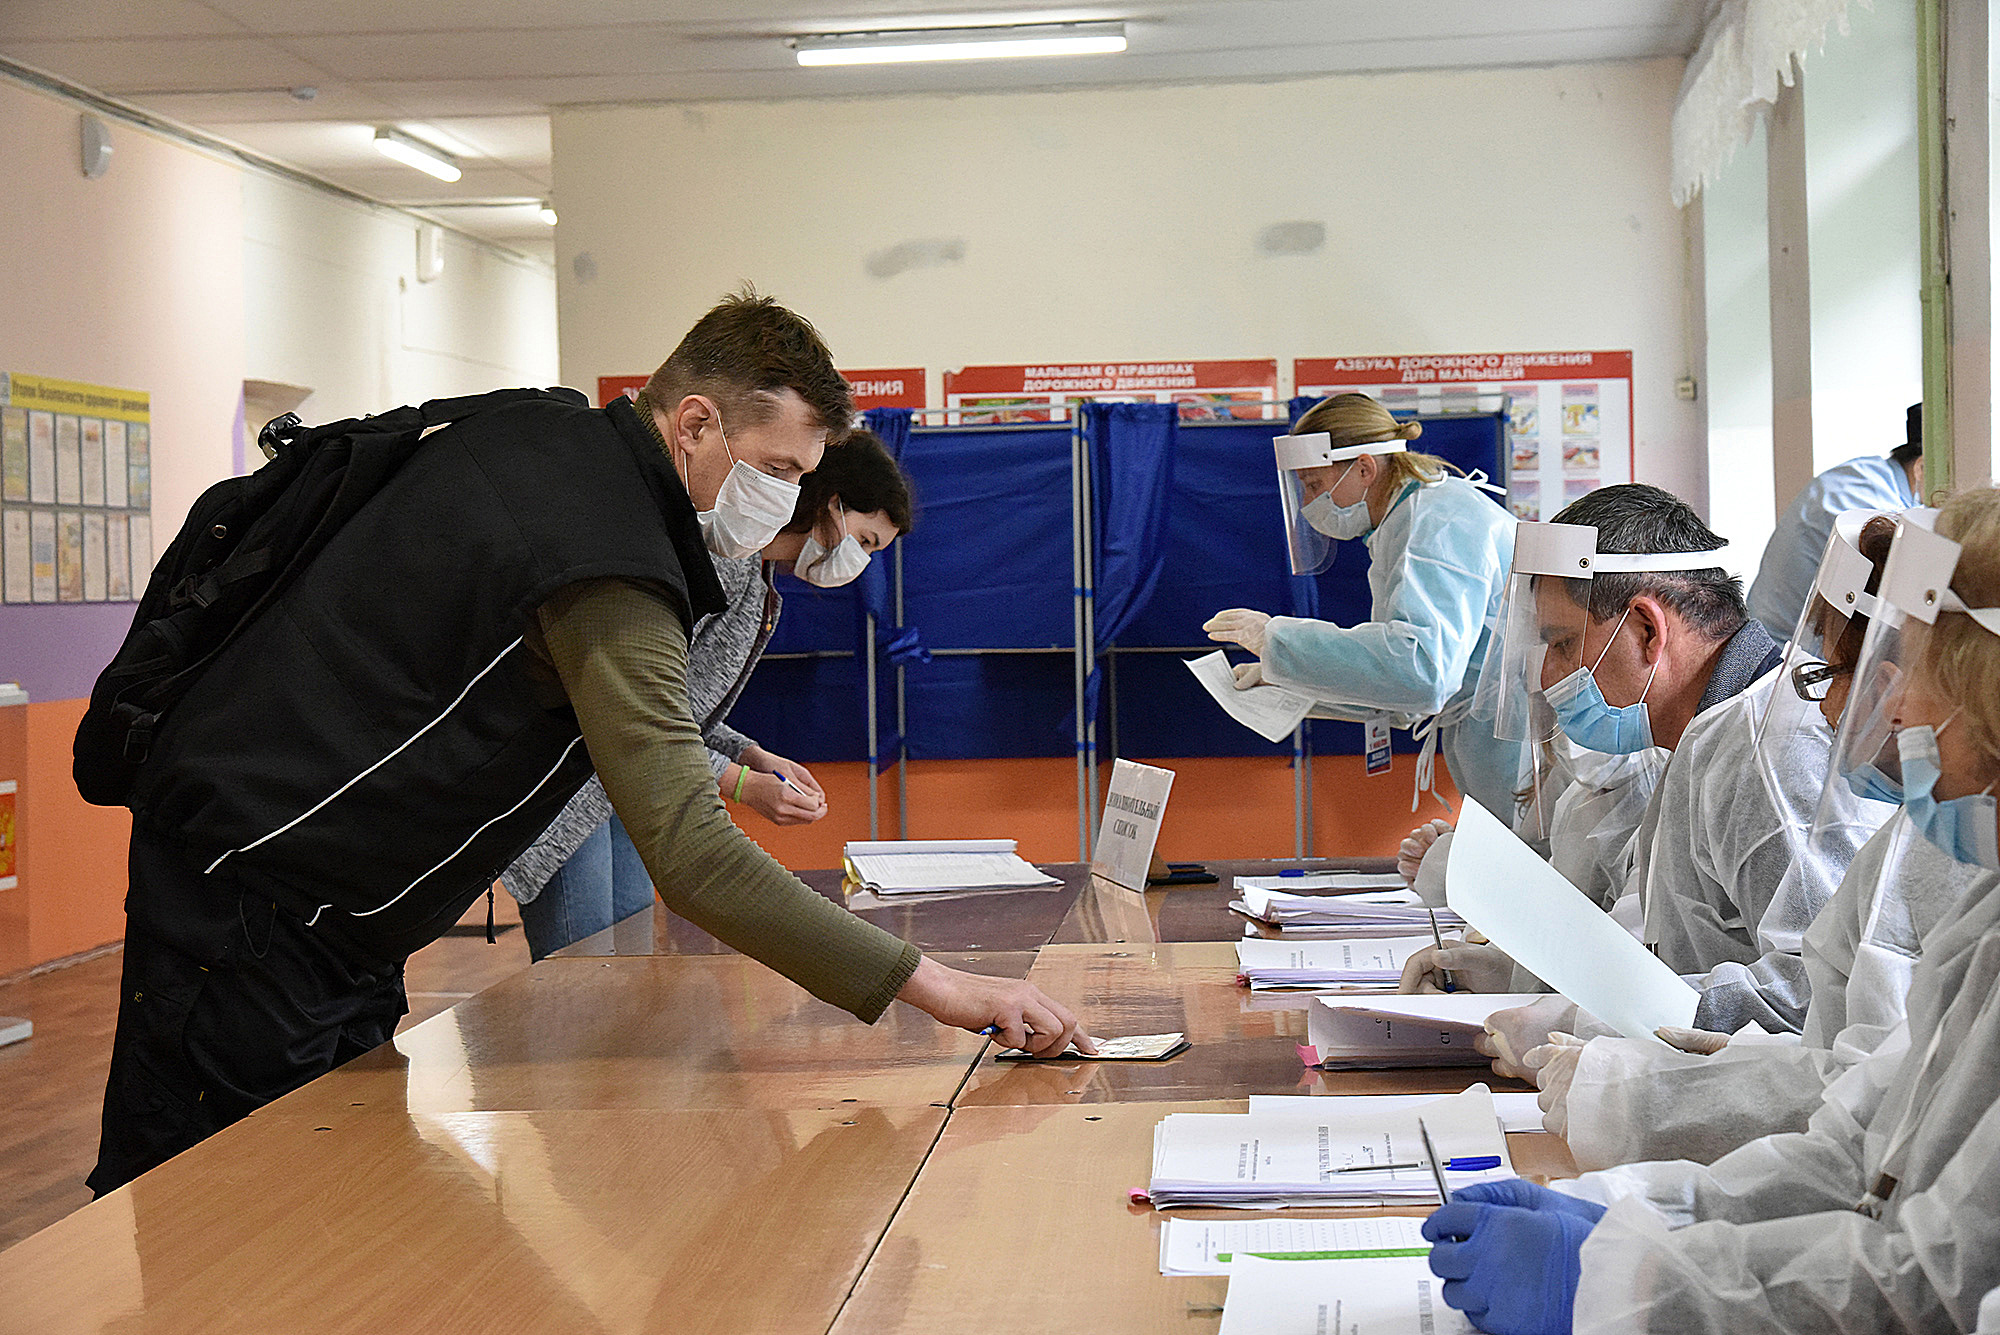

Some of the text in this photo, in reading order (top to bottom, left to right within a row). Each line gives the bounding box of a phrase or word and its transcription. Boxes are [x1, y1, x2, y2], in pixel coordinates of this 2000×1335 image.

[1334, 353, 1593, 371] АЗБУКА ДОРОЖНОГО ДВИЖЕНИЯ
[1025, 364, 1195, 378] МАЛЫШАМ О ПРАВИЛАХ
[1401, 366, 1525, 382] ДЛЯ МАЛЫШЕЙ
[1023, 376, 1197, 392] ДОРОЖНОГО ДВИЖЕНИЯ
